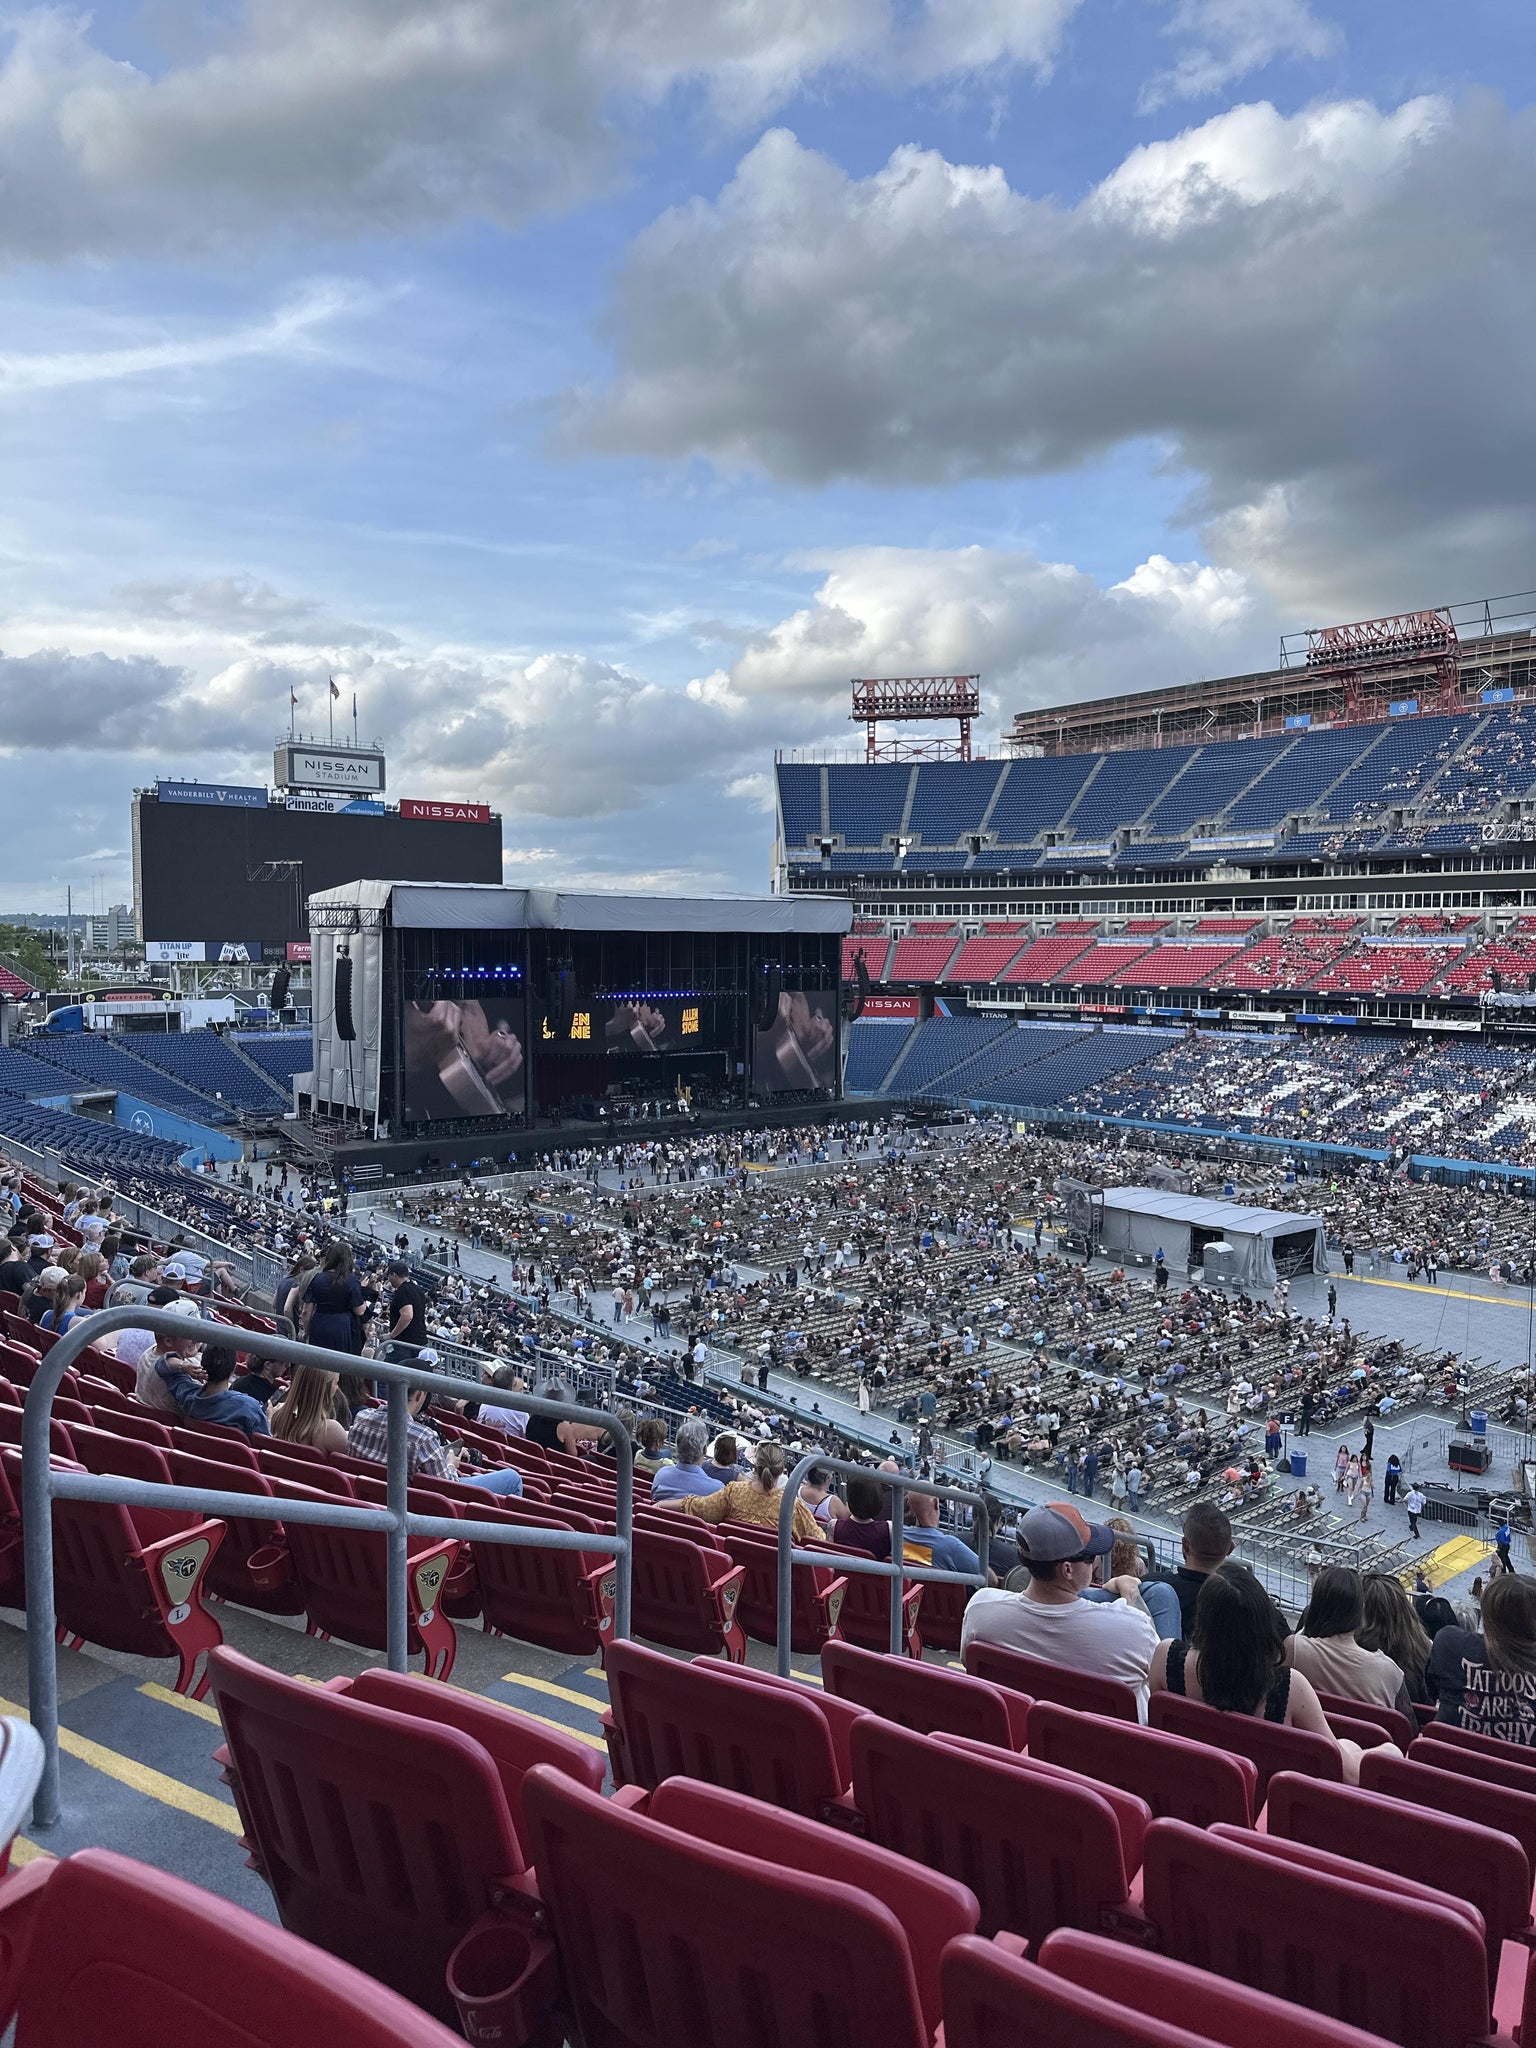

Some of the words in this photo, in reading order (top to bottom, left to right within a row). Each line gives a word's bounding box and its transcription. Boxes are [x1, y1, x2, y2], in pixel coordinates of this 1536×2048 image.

[305, 760, 368, 774] NISSAN
[316, 771, 359, 781] STADIUM
[168, 790, 215, 799] VANDERBILT
[228, 793, 258, 801] HEALTH
[287, 797, 335, 812] Pinnacle
[412, 805, 479, 819] NISSAN
[159, 942, 180, 950] TITAN
[181, 942, 193, 950] UP
[293, 944, 312, 952] Farm
[175, 951, 190, 960] Lite
[864, 1000, 911, 1008] NISSAN
[682, 1008, 699, 1022] ALLEN
[682, 1020, 699, 1035] STONE
[1284, 1415, 1291, 1424] F
[175, 1609, 184, 1620] L
[423, 1612, 430, 1623] K
[1460, 1657, 1536, 1700] TATTOOS
[1479, 1695, 1515, 1719] ARE
[1458, 1705, 1536, 1746] TRASHY
